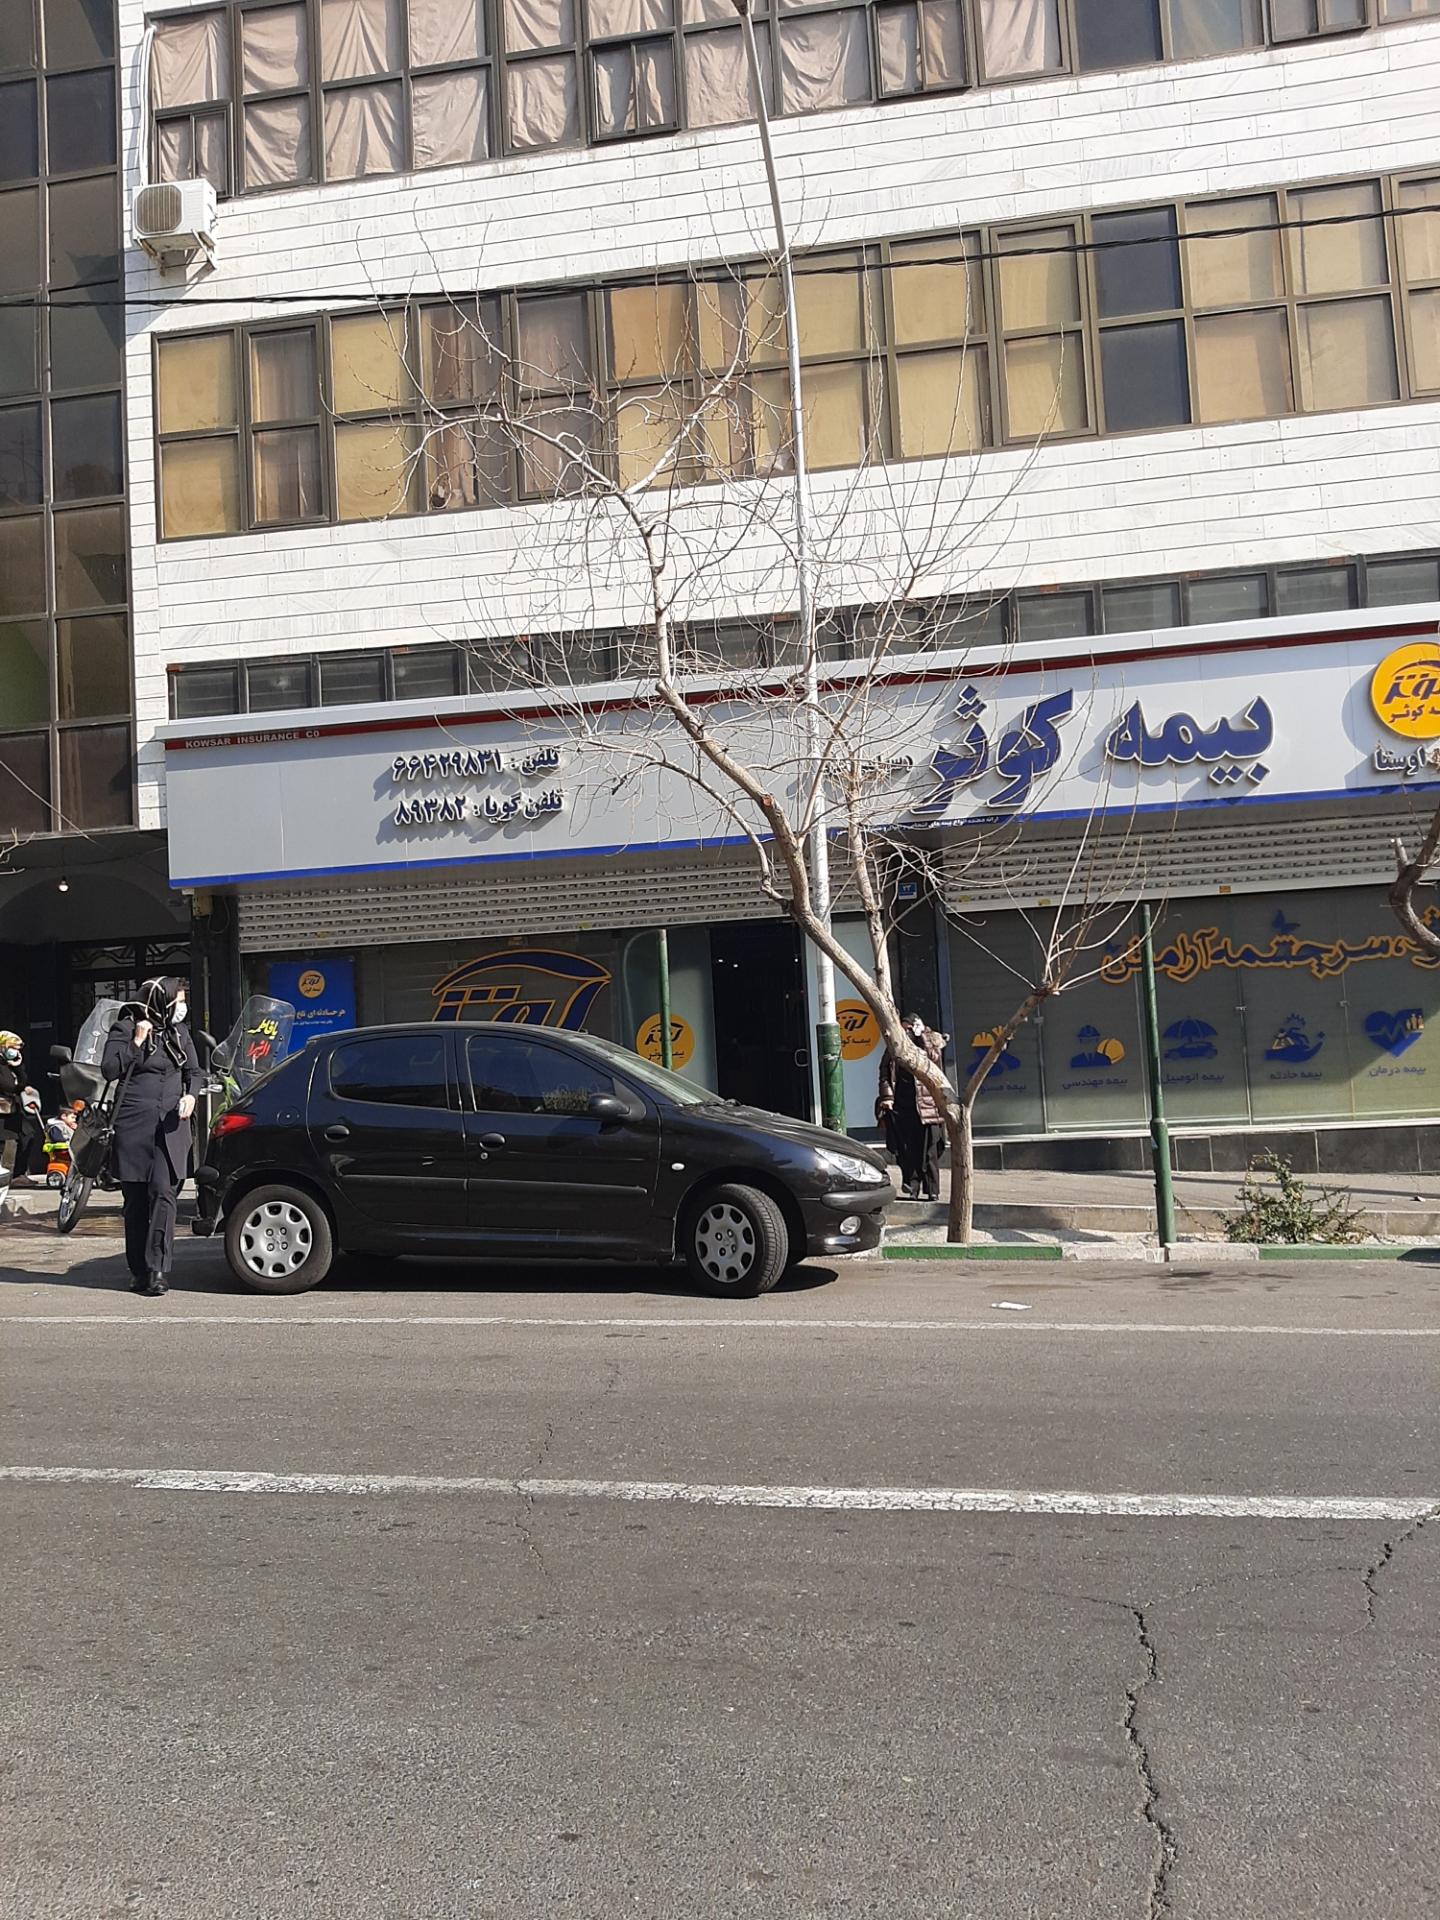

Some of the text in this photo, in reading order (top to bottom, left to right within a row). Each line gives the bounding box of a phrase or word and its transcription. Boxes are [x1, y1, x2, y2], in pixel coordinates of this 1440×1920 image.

[185, 738, 231, 749] KOWSAR
[237, 732, 299, 744] INSURANCE
[910, 684, 1274, 814] بیمه کوثر
[394, 795, 467, 826] ۸۹۳۸۲
[523, 788, 565, 819] تلفن
[1368, 1064, 1427, 1078] بیمه درمان
[1062, 1077, 1129, 1090] بیمه مهندسی
